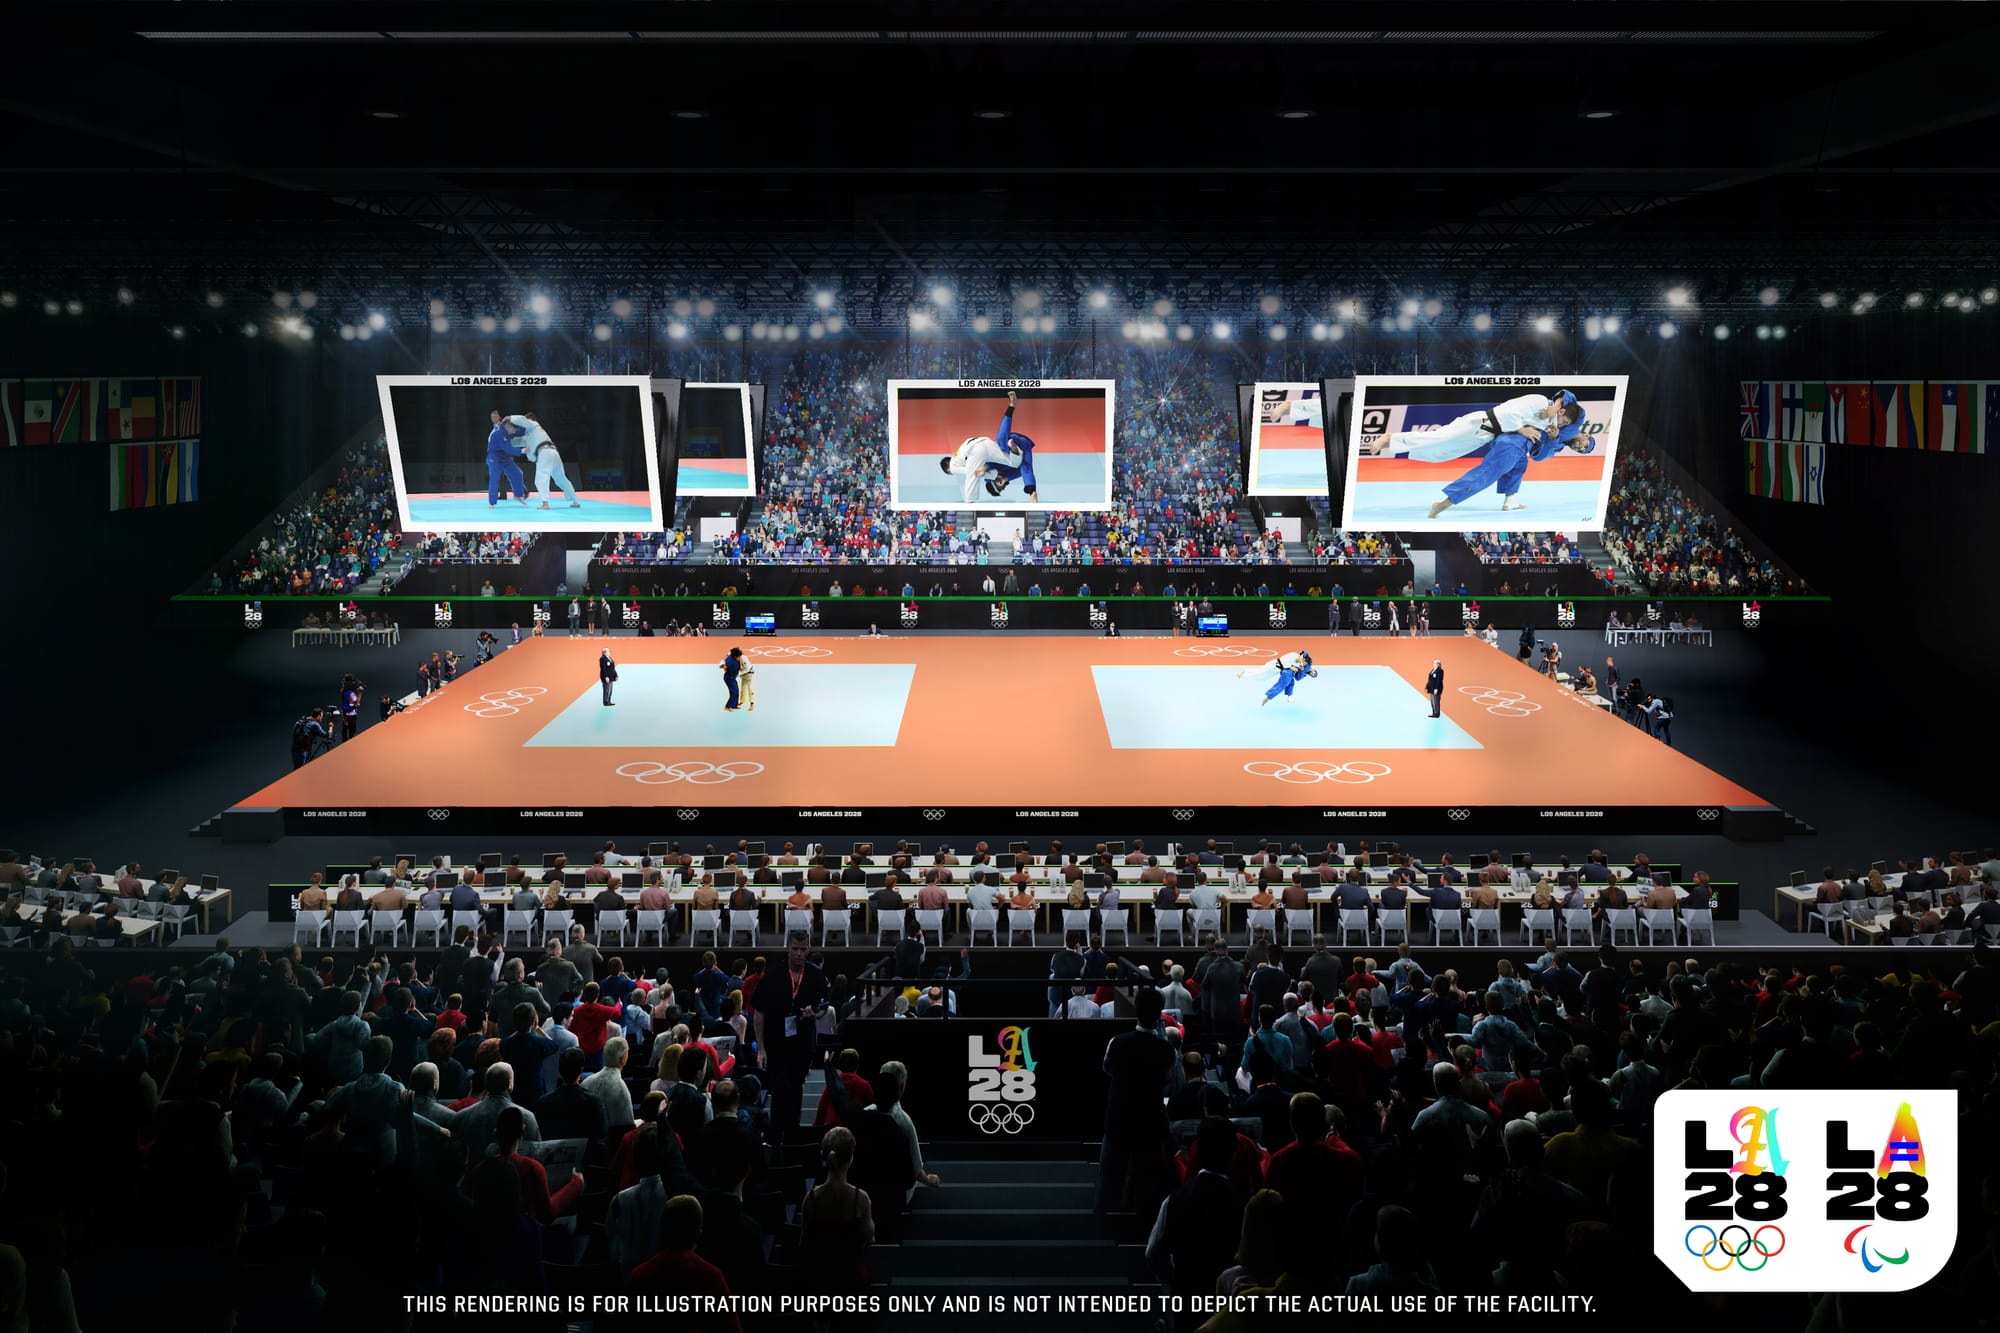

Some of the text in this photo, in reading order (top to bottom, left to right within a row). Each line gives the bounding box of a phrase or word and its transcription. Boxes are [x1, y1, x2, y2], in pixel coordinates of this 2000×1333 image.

[451, 377, 547, 385] LOS ANGELES 2028
[958, 380, 1041, 388] LOS ANGELES 2028
[1444, 377, 1541, 385] LOS ANGELES 2028
[340, 600, 358, 611] LA
[623, 600, 641, 611] LA
[901, 600, 919, 611] LA
[1463, 600, 1481, 611] LA
[1743, 600, 1761, 611] LA
[245, 612, 263, 620] 28
[435, 612, 452, 620] 28
[534, 612, 550, 620] 28
[623, 611, 640, 619] 28
[713, 612, 730, 620] 28
[802, 612, 819, 620] 28
[901, 611, 918, 619] 28
[991, 612, 1008, 620] 28
[1090, 612, 1107, 620] 28
[1269, 612, 1287, 620] 28
[1364, 612, 1381, 620] 28
[1463, 611, 1480, 619] 28
[1558, 612, 1575, 620] 28
[1743, 611, 1760, 619] 28
[968, 1026, 1038, 1072] LA
[968, 1069, 1036, 1101] 28
